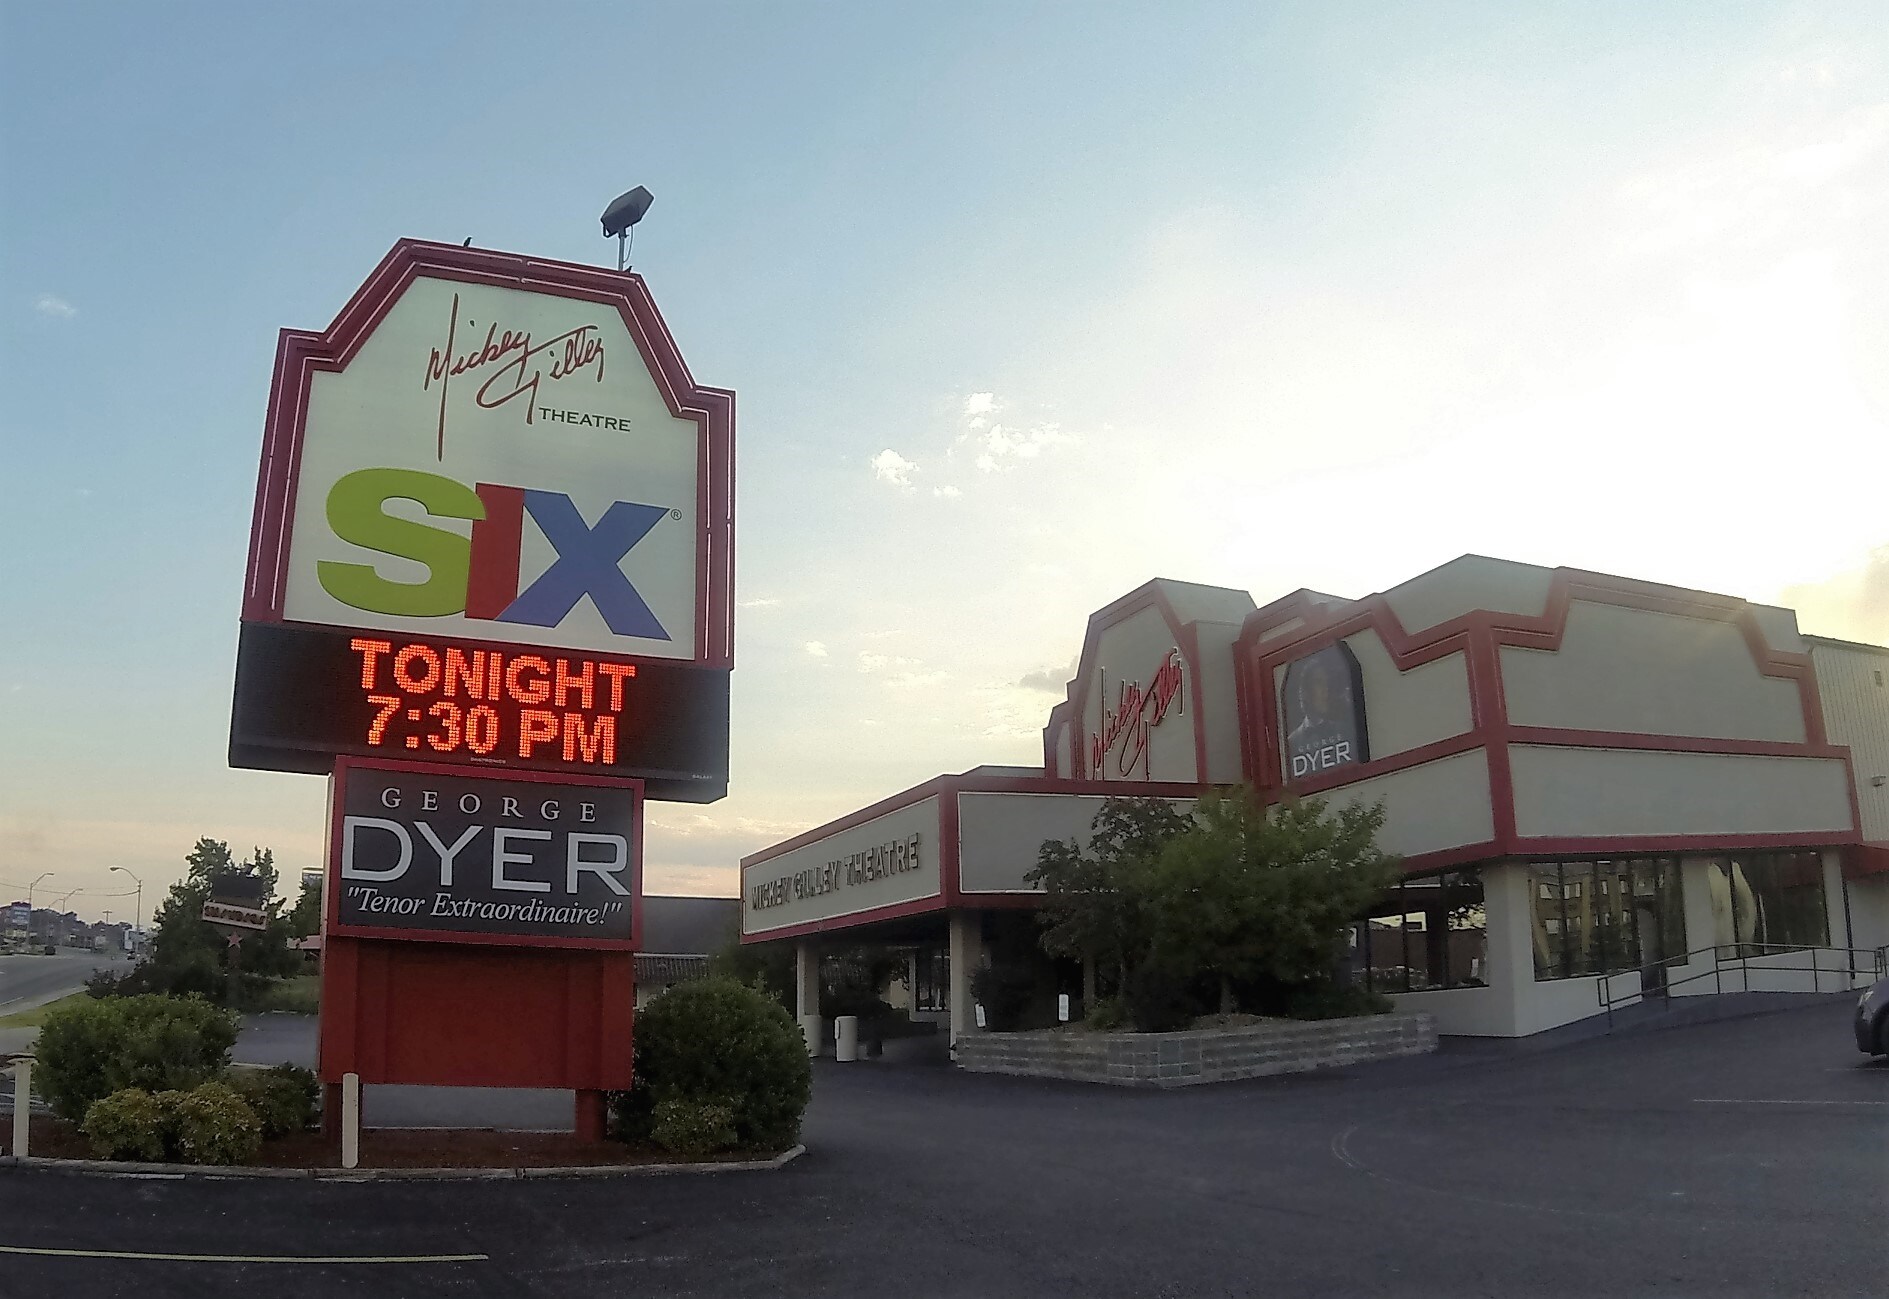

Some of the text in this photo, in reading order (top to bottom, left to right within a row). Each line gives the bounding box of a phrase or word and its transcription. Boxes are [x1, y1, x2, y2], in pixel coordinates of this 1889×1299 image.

[424, 293, 531, 462] Mickey
[538, 407, 631, 432] THEATRE
[317, 467, 671, 641] SIX
[351, 639, 637, 712] TONIGHT
[367, 695, 616, 765] 7:30 PM
[1293, 741, 1351, 776] DYER
[381, 788, 596, 822] GEORGE
[341, 816, 631, 896] DYER
[752, 832, 920, 911] MICKEY GILLEY THEATRE
[347, 886, 622, 925] "Tenor Extraordinaire!"
